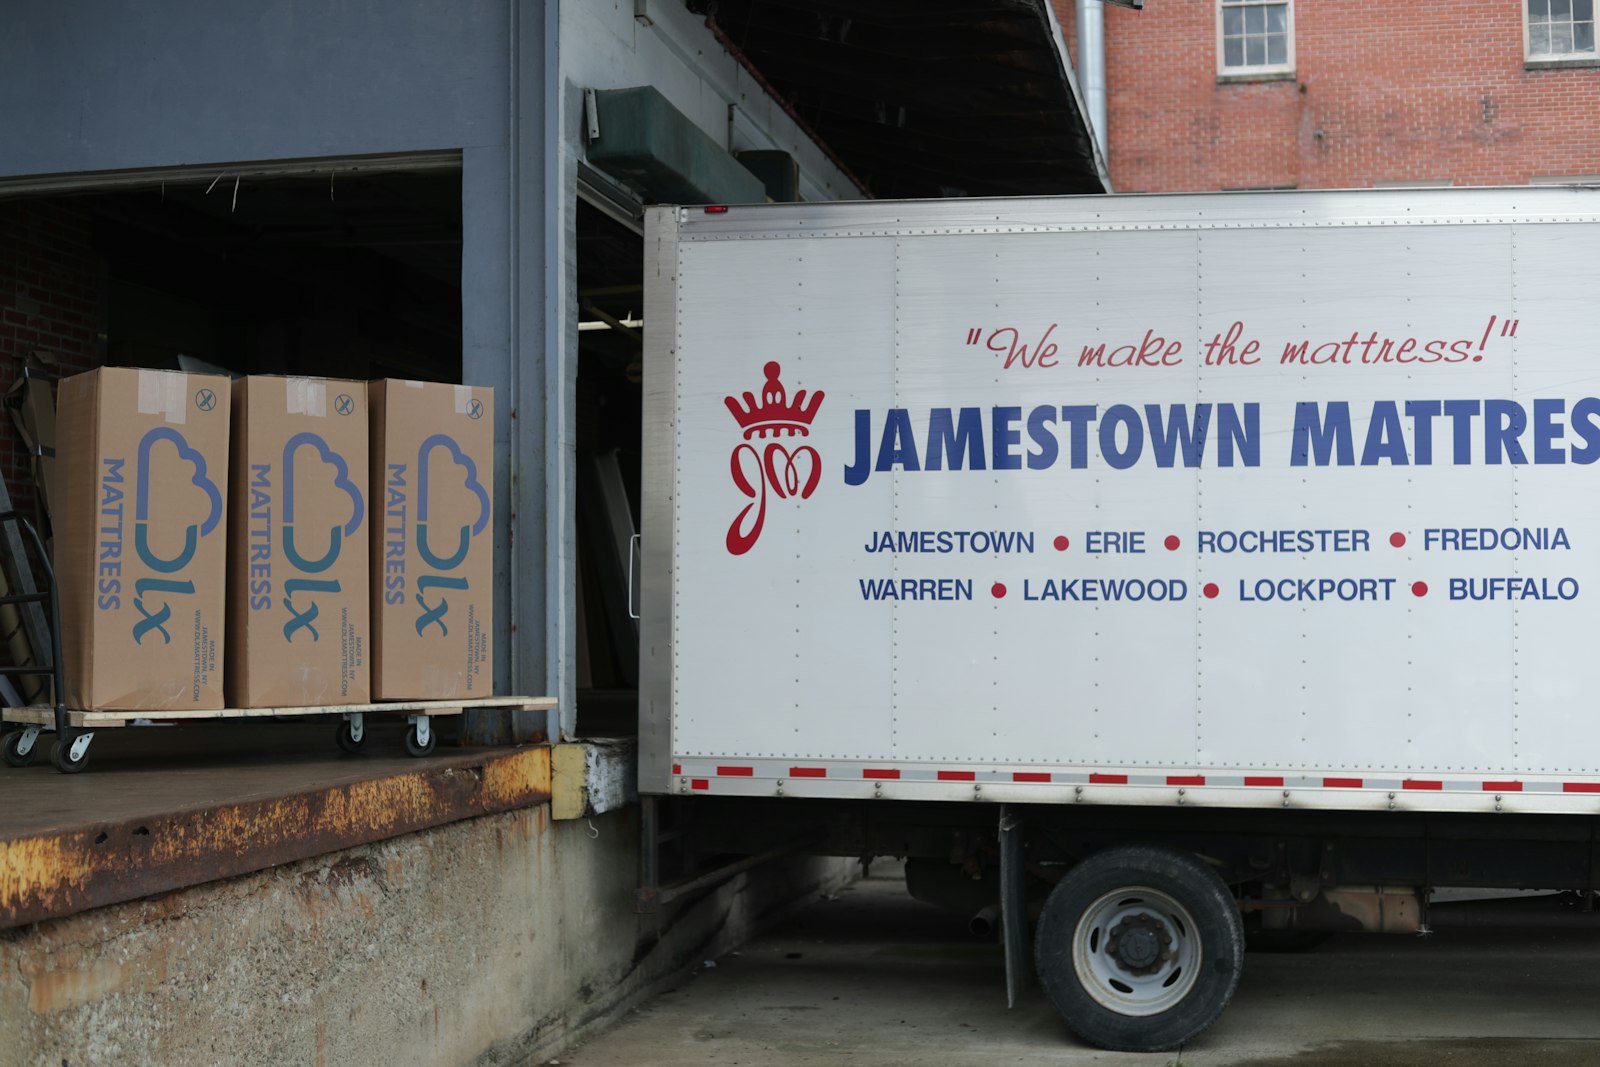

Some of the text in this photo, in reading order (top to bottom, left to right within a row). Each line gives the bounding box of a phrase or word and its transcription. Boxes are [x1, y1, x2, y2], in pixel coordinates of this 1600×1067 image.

[1078, 330, 1183, 367] make
[1204, 321, 1261, 366] the
[1280, 315, 1519, 364] mattress!"
[844, 402, 1260, 486] JAMESTOWN
[98, 458, 125, 610] MATTRESS
[250, 464, 272, 611] MATTRESS
[385, 464, 407, 605] MATTRESS
[864, 528, 1571, 555] JAMESTOWN ERIE ROCHESTER FREDONIA
[859, 576, 1580, 602] WARREN LAKEWOOD LOCKPORT BUFFALO
[193, 608, 201, 702] WWW.DLXMATTRESS.COM
[209, 663, 215, 672] IN
[356, 659, 362, 667] IN
[481, 654, 487, 662] IN
